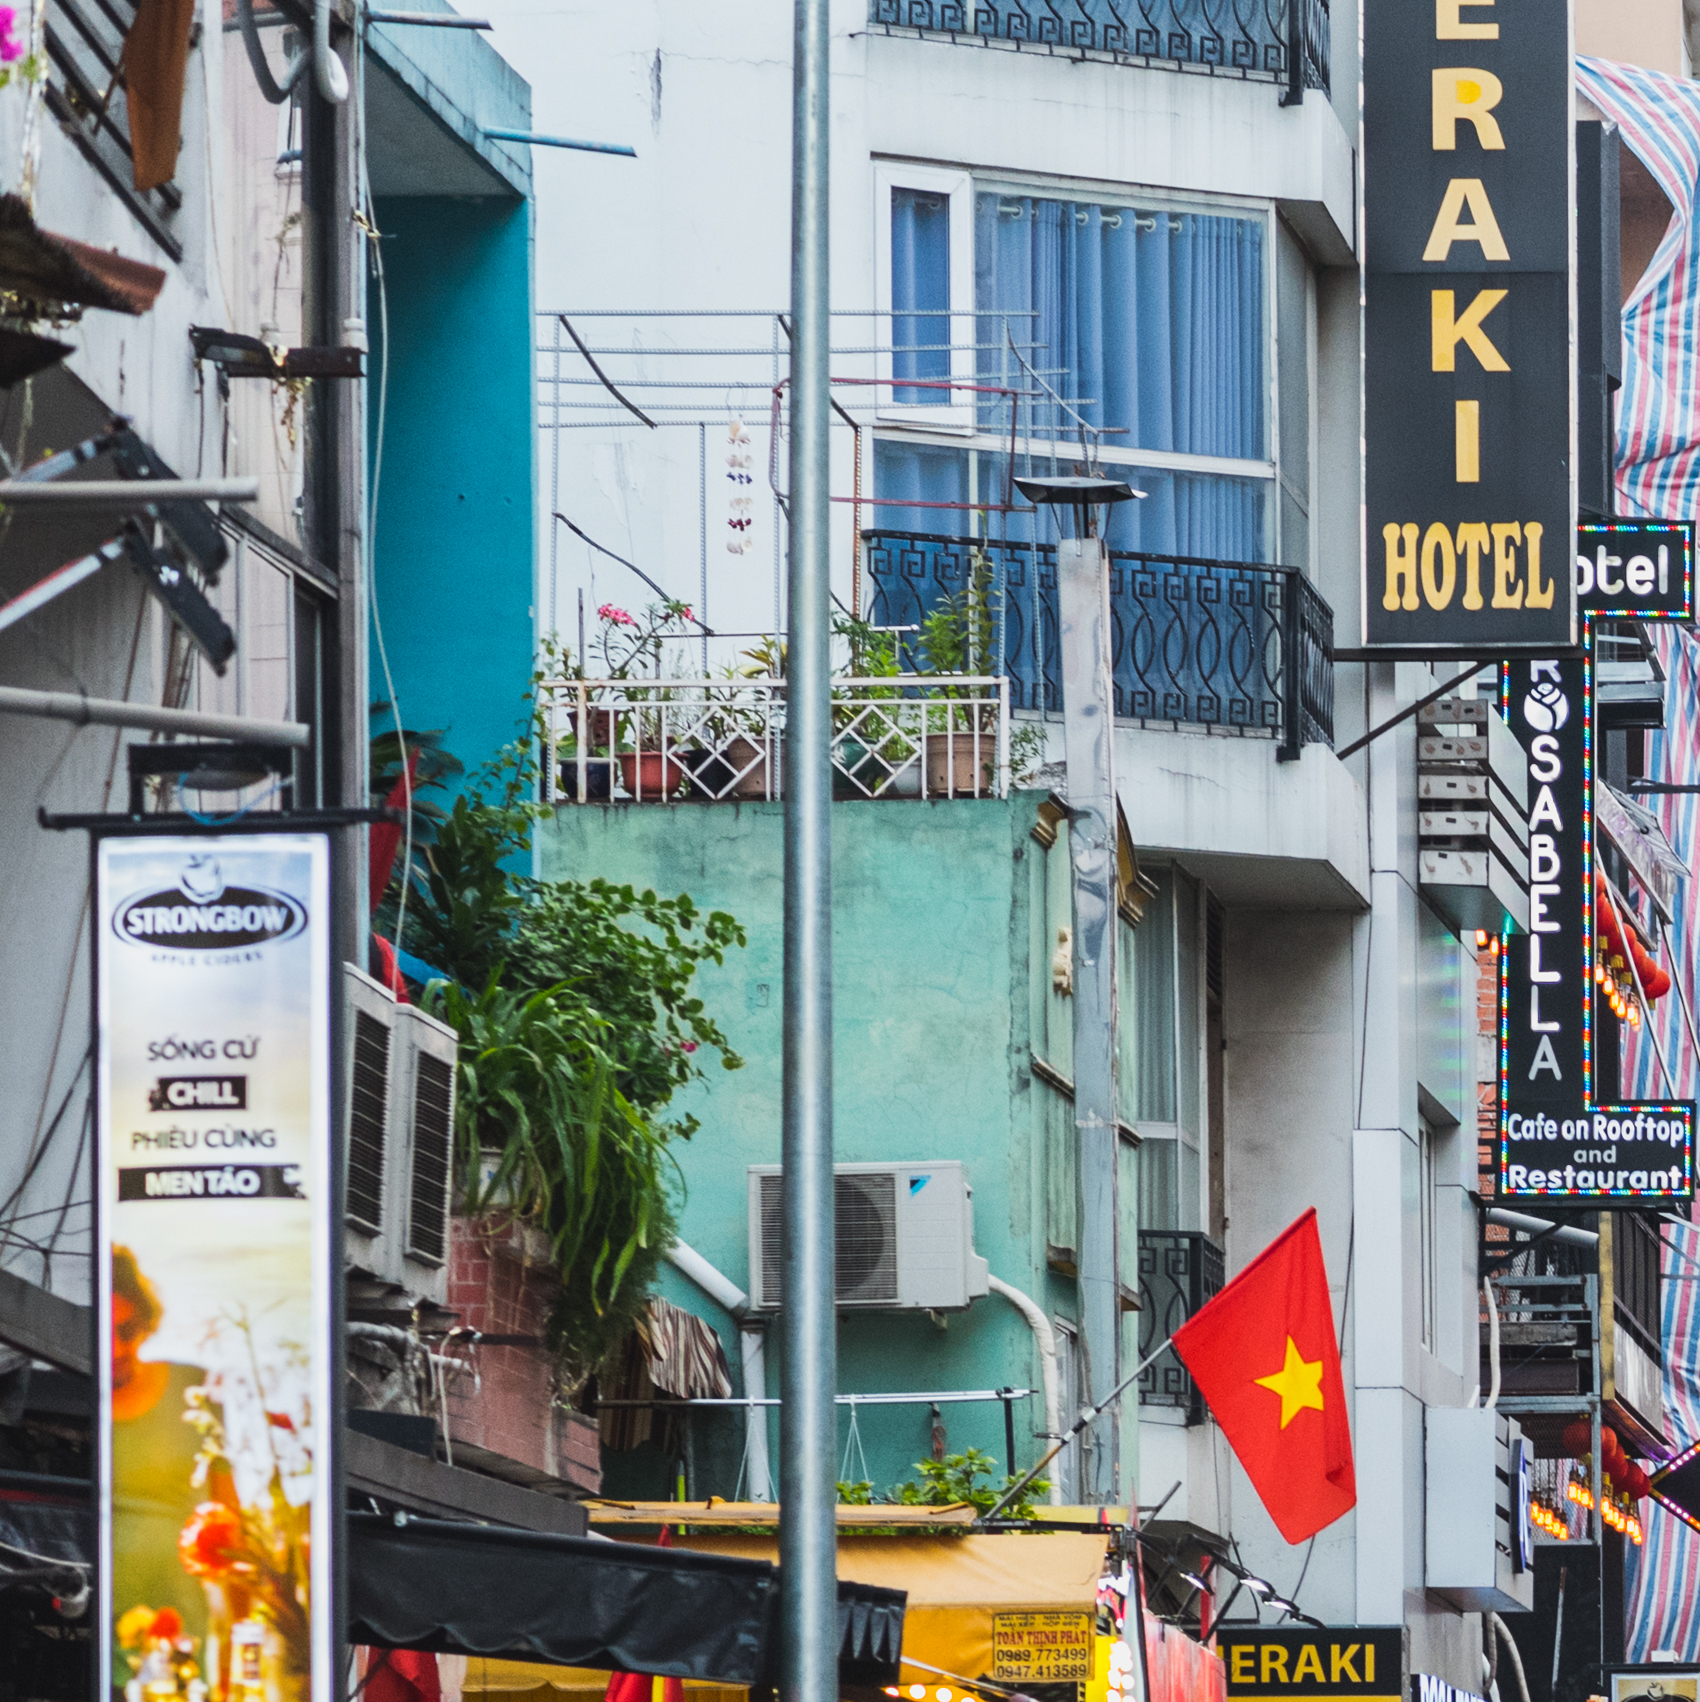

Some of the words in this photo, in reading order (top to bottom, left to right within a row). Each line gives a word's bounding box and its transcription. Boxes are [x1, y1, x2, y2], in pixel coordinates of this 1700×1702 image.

[1382, 522, 1554, 611] HOTEL
[126, 905, 288, 934] STRONGBOW
[166, 1081, 239, 1106] CHILL
[1507, 1113, 1559, 1140] Cafe
[1562, 1118, 1589, 1140] on
[1593, 1113, 1685, 1148] Rooftop
[1573, 1146, 1617, 1165] and
[145, 1171, 201, 1196] MEN
[203, 1165, 261, 1195] TÁO
[1508, 1165, 1684, 1190] Restaurant
[996, 1648, 1087, 1663] 0989.773499
[996, 1664, 1087, 1678] 0947.413589
